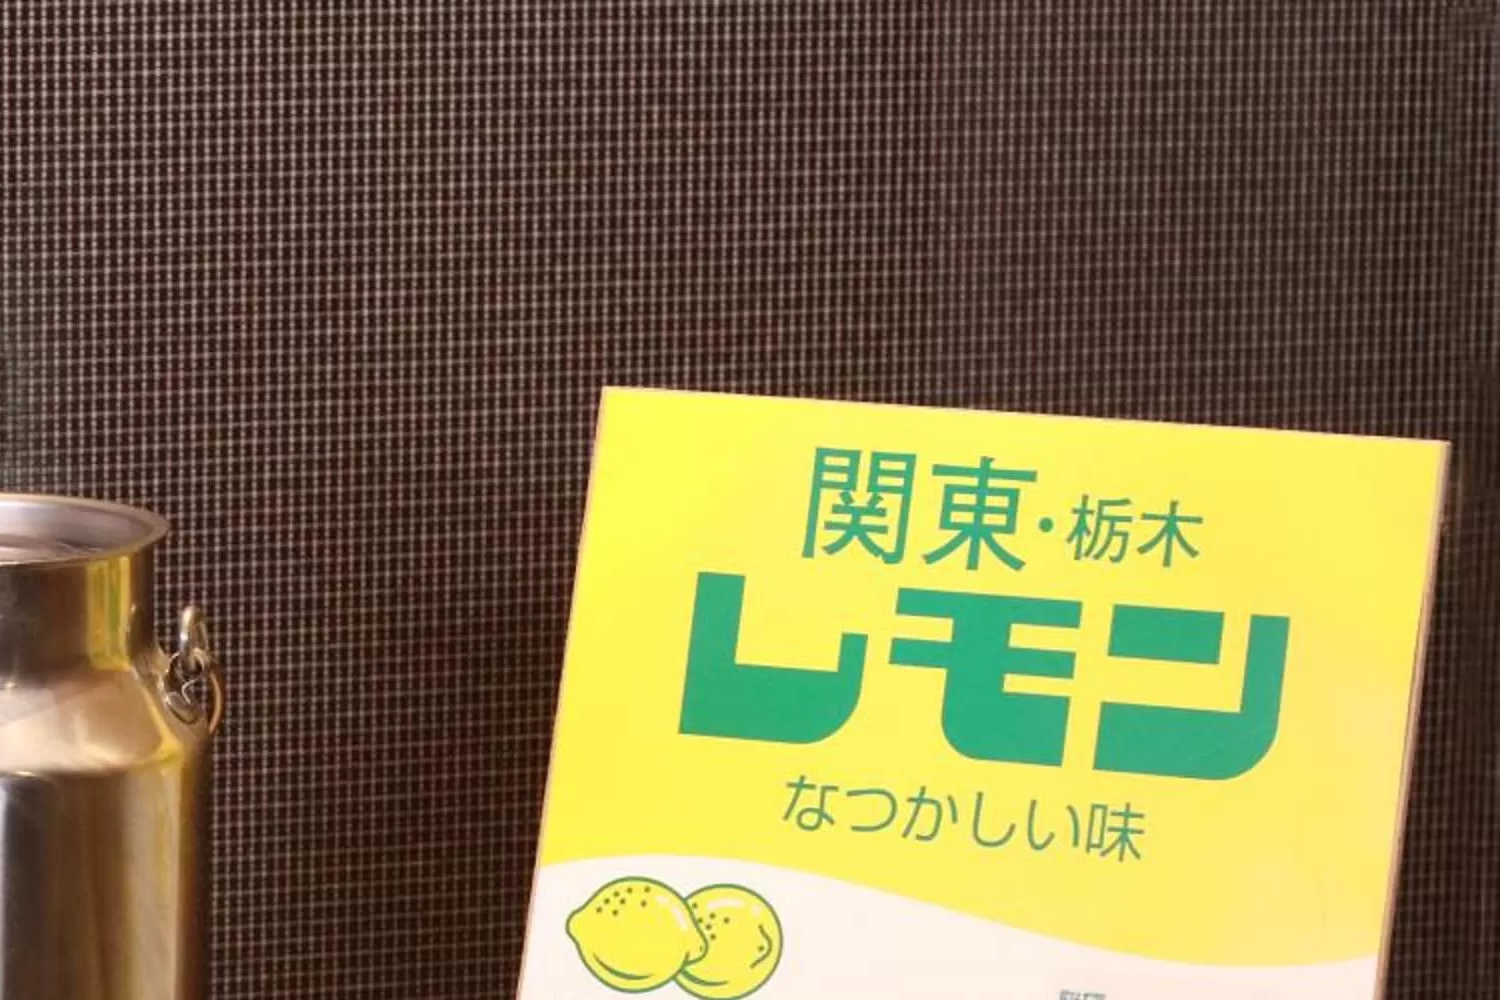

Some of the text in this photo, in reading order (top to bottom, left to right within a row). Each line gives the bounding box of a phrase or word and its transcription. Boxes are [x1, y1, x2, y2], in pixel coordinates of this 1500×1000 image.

[801, 446, 1205, 572] 関東・栃木
[678, 571, 1290, 782] レモン
[781, 774, 1148, 863] なつかしい味
